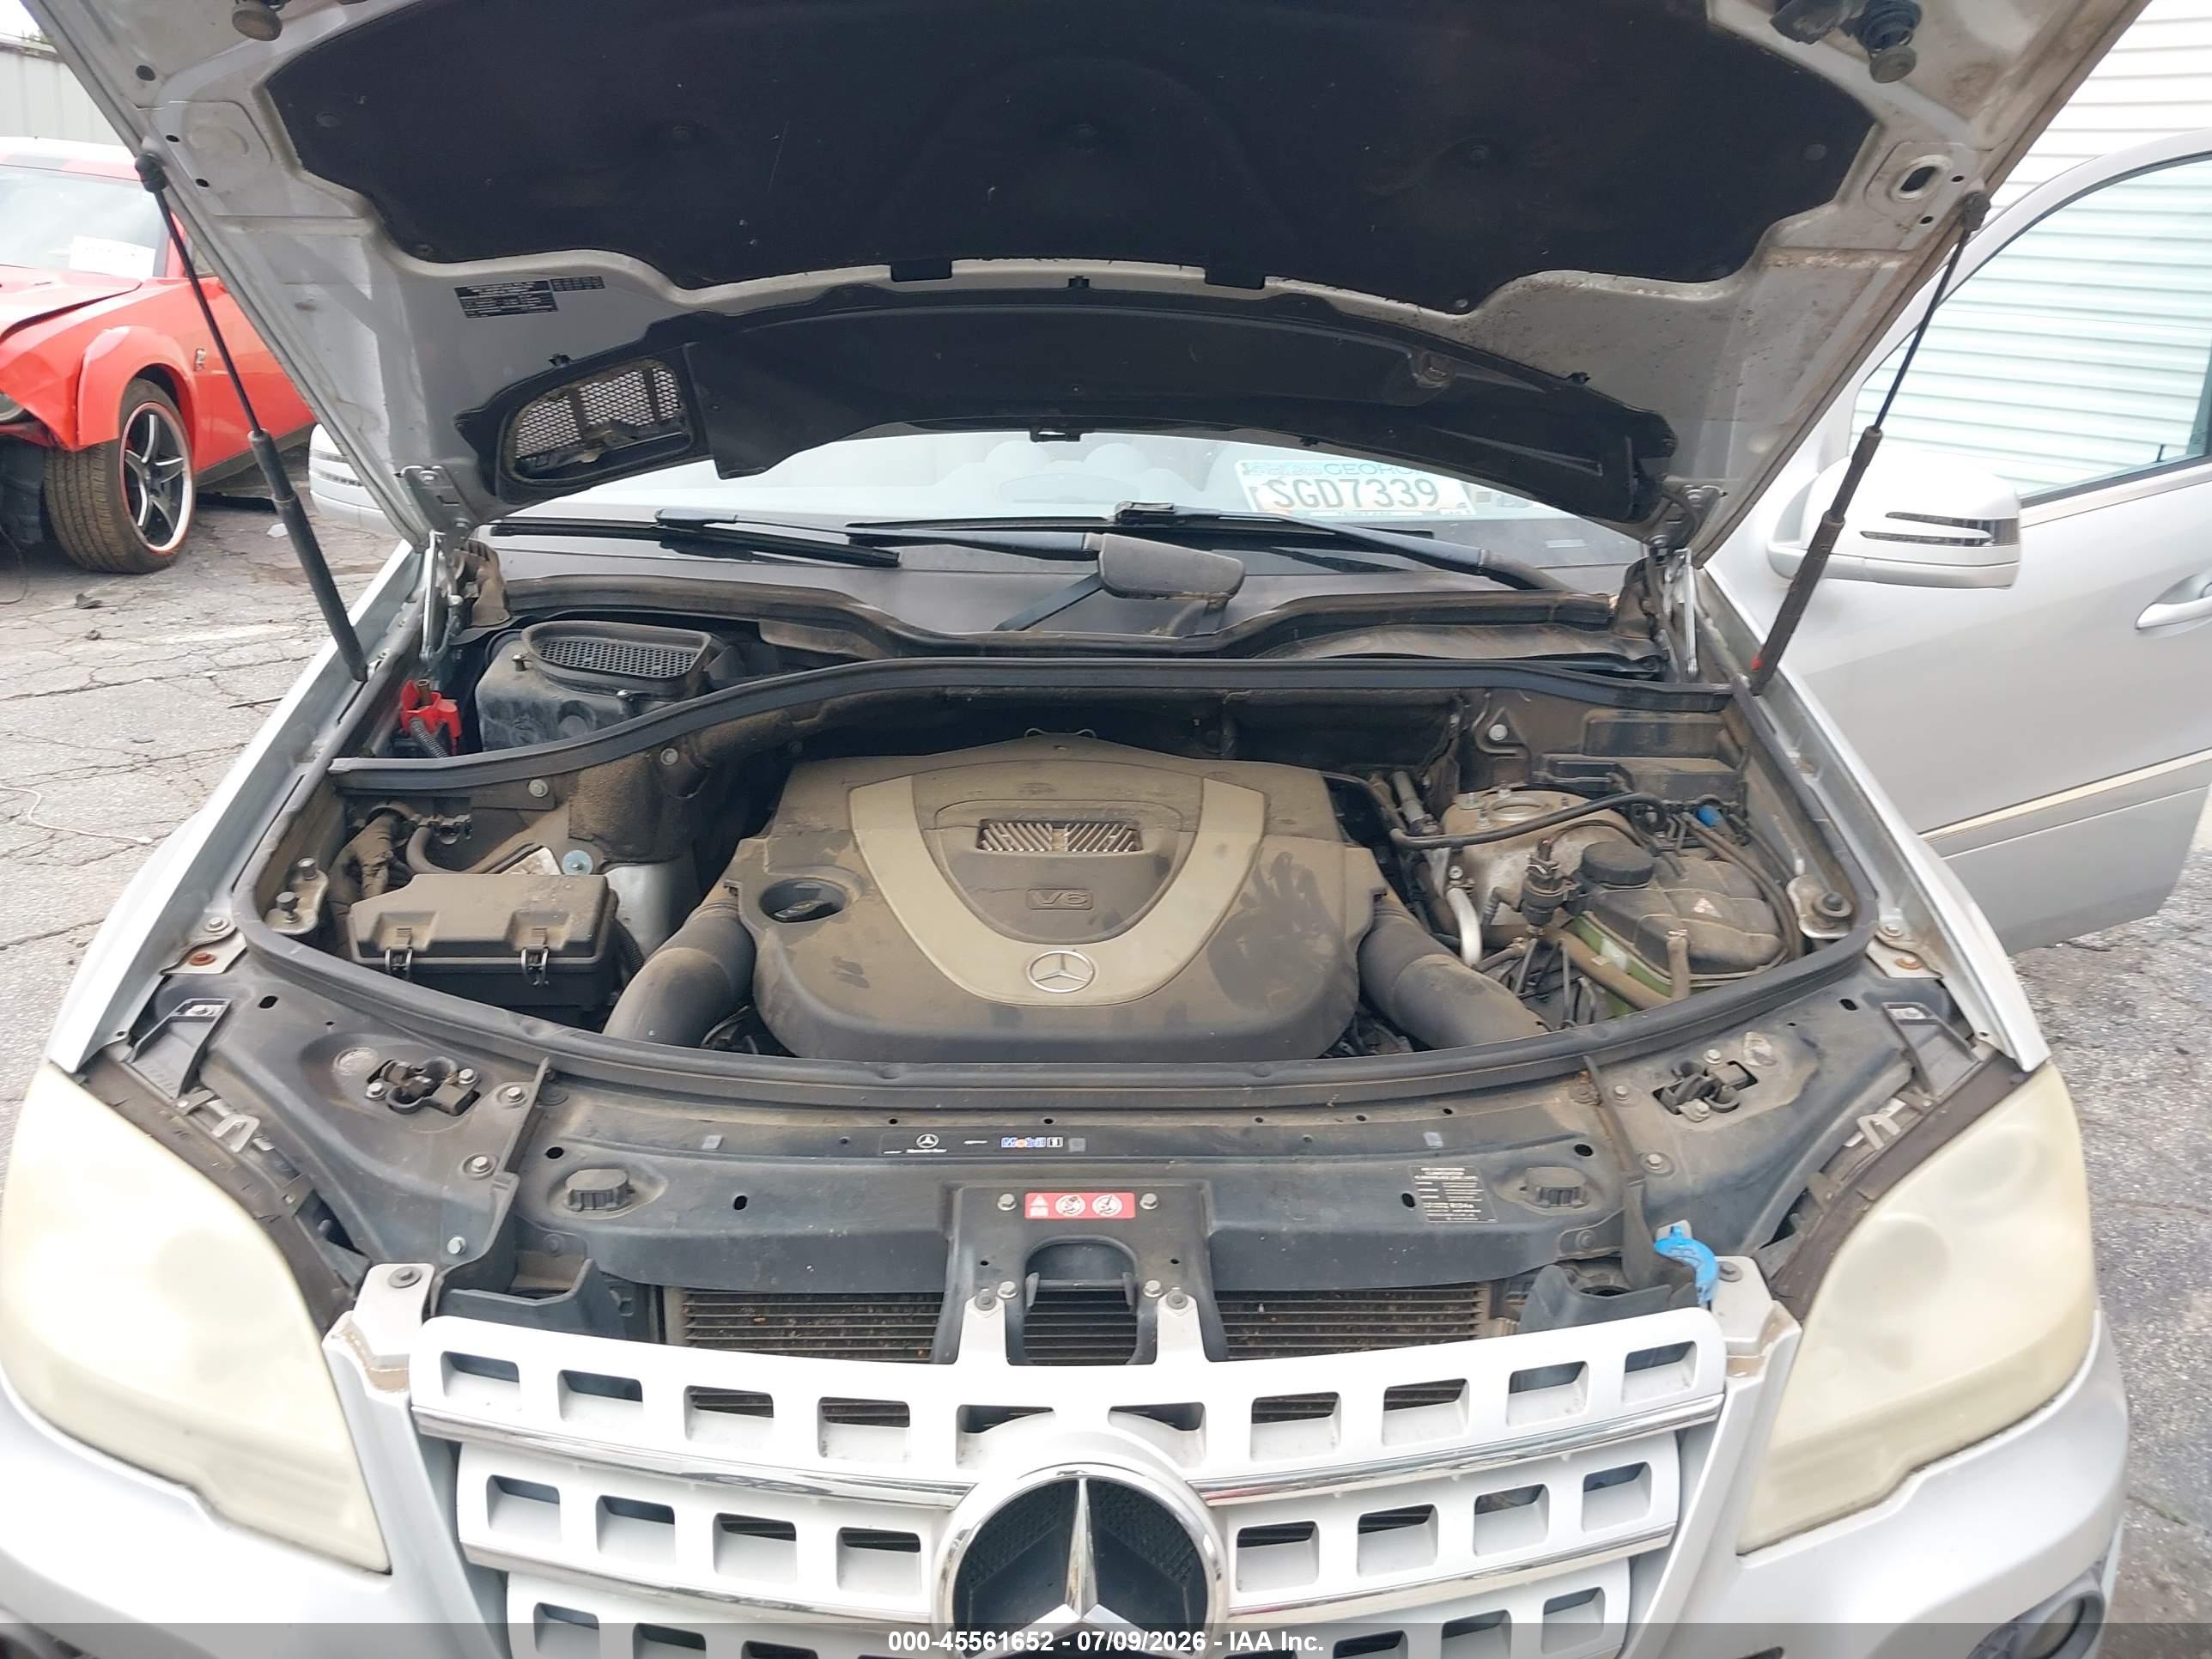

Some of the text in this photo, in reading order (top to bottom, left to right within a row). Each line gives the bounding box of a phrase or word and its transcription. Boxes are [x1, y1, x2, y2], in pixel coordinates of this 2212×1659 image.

[1324, 463, 1423, 475] GEORG
[1264, 478, 1439, 508] SGD7339
[1031, 890, 1089, 906] V6
[1001, 1136, 1046, 1147] Mobil
